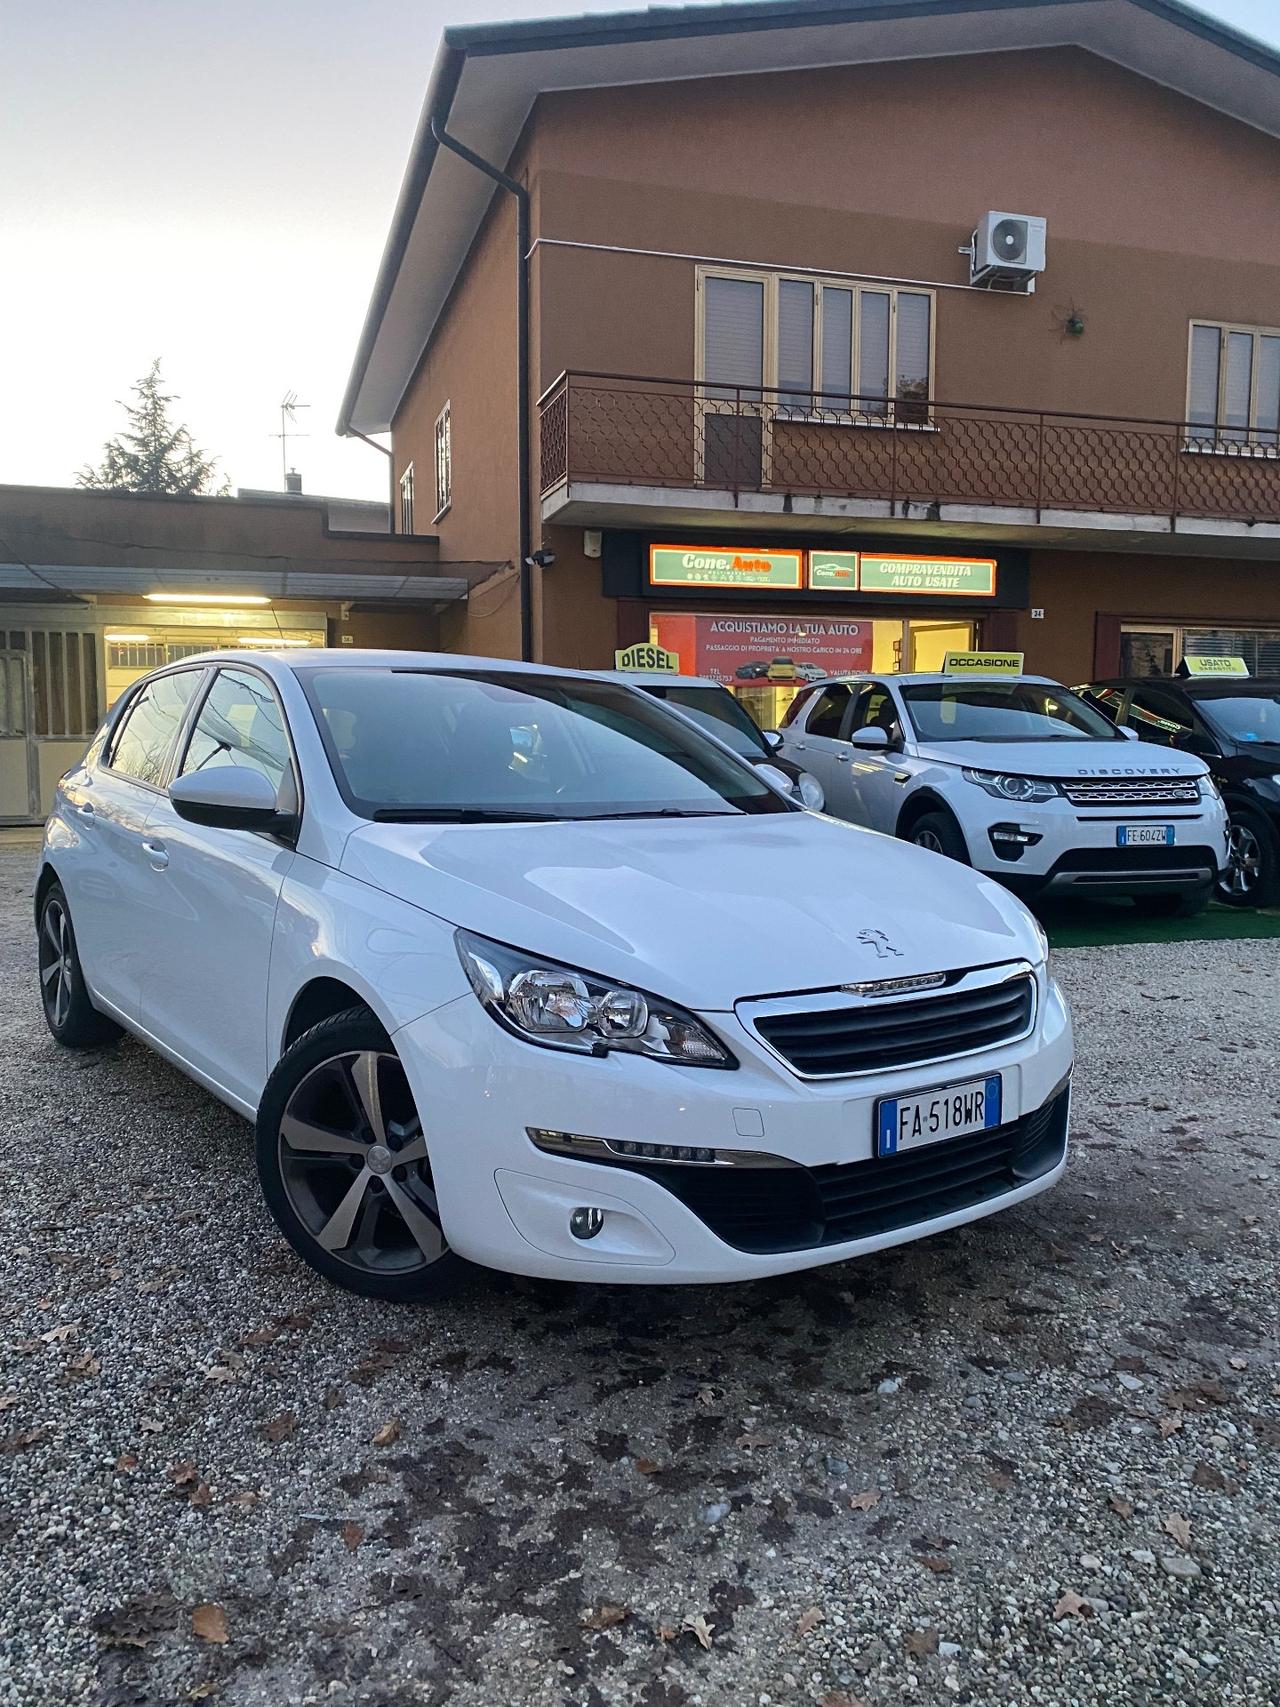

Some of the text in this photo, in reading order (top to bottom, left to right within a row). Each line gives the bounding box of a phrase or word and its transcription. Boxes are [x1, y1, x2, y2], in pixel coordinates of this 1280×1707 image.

[879, 562, 972, 577] COMPRAVENDITA
[891, 576, 960, 588] AUTO USATE
[710, 621, 859, 636] ACQUISTIAMO LA TUA AUTO
[750, 636, 786, 644] PAGAMENTO
[622, 647, 674, 669] DIESEL
[949, 658, 1020, 667] OCCASIONE
[1078, 767, 1181, 776] DISCOVERY
